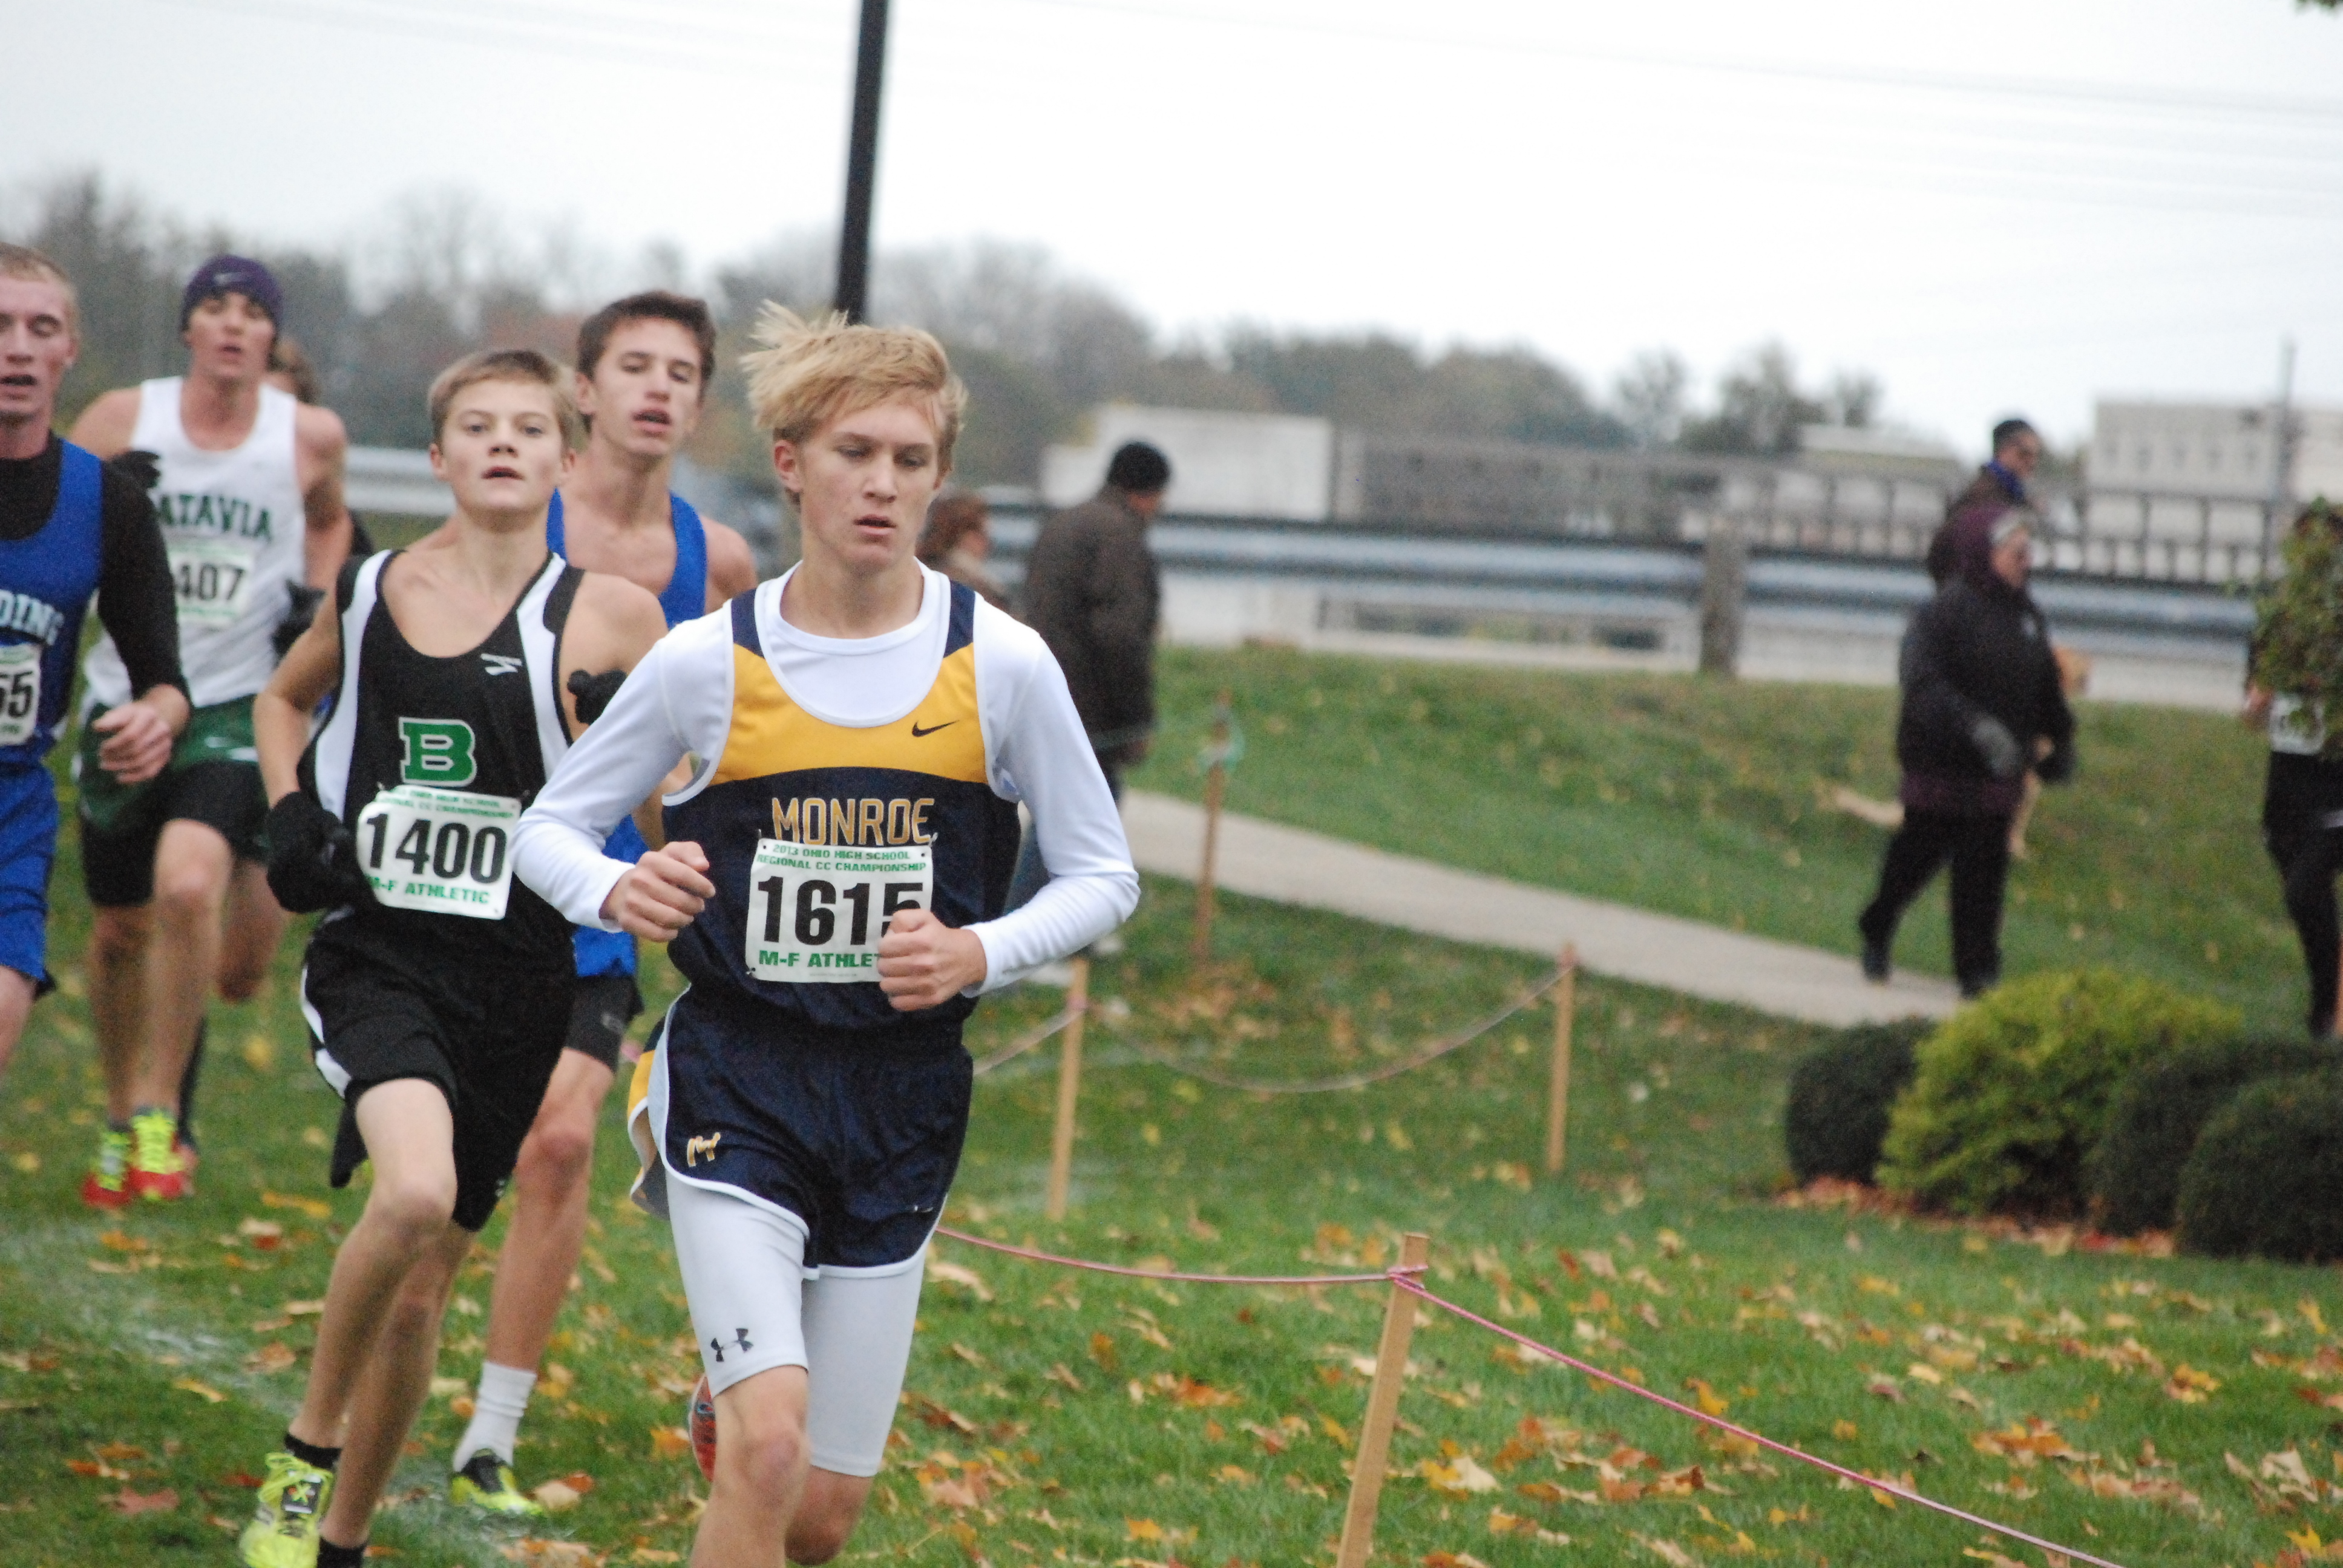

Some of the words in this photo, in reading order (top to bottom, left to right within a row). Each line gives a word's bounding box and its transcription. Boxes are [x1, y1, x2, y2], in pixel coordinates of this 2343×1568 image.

[398, 717, 477, 786] B
[772, 797, 935, 846] MONROE
[366, 814, 507, 884] 1400
[757, 854, 811, 869] REGIONAL
[816, 861, 831, 871] CC
[835, 862, 926, 872] CHAMPIONSHIP
[773, 844, 798, 855] 2013
[802, 849, 830, 858] OHIO
[834, 851, 862, 860] HIGH
[866, 851, 911, 860] SCHOOL
[405, 883, 490, 904] ATHLETIC
[758, 876, 923, 946] 1615
[759, 950, 800, 967] M-F
